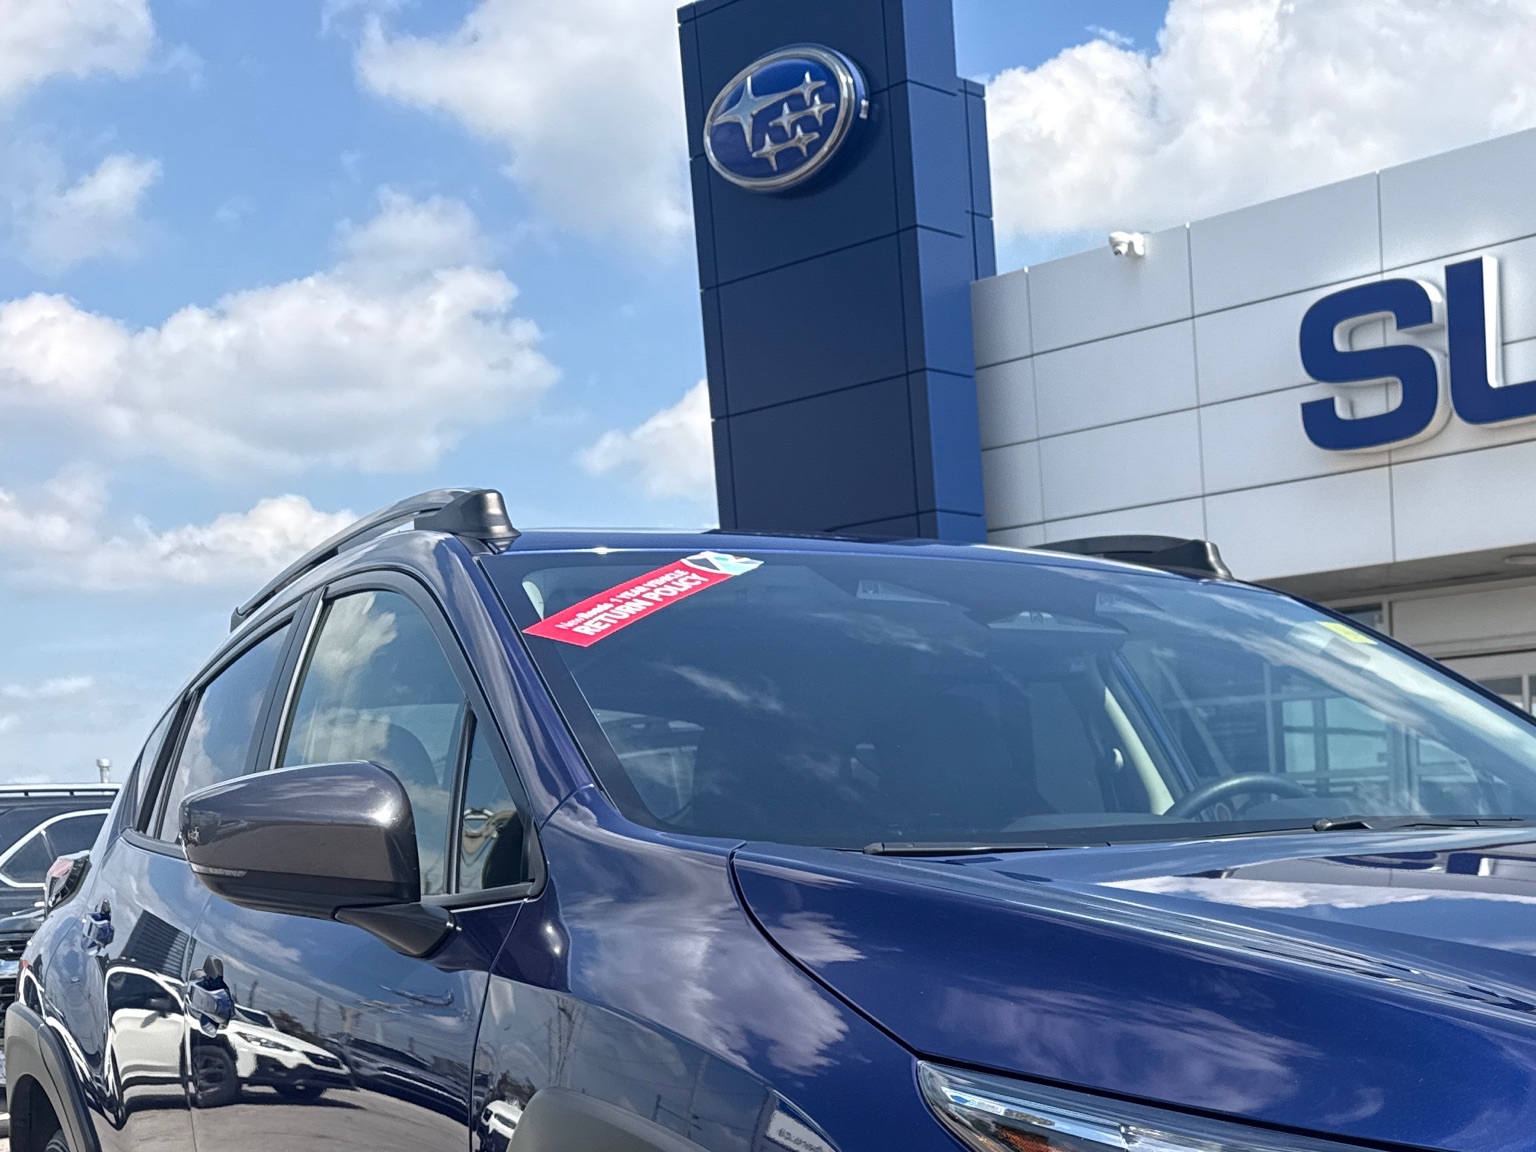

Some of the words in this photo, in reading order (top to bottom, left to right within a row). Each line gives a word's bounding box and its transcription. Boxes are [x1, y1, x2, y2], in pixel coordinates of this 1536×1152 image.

[571, 598, 654, 636] RETURN
[643, 572, 709, 602] POLICY
[616, 586, 646, 600] YEAR
[644, 568, 690, 588] VEHICLE
